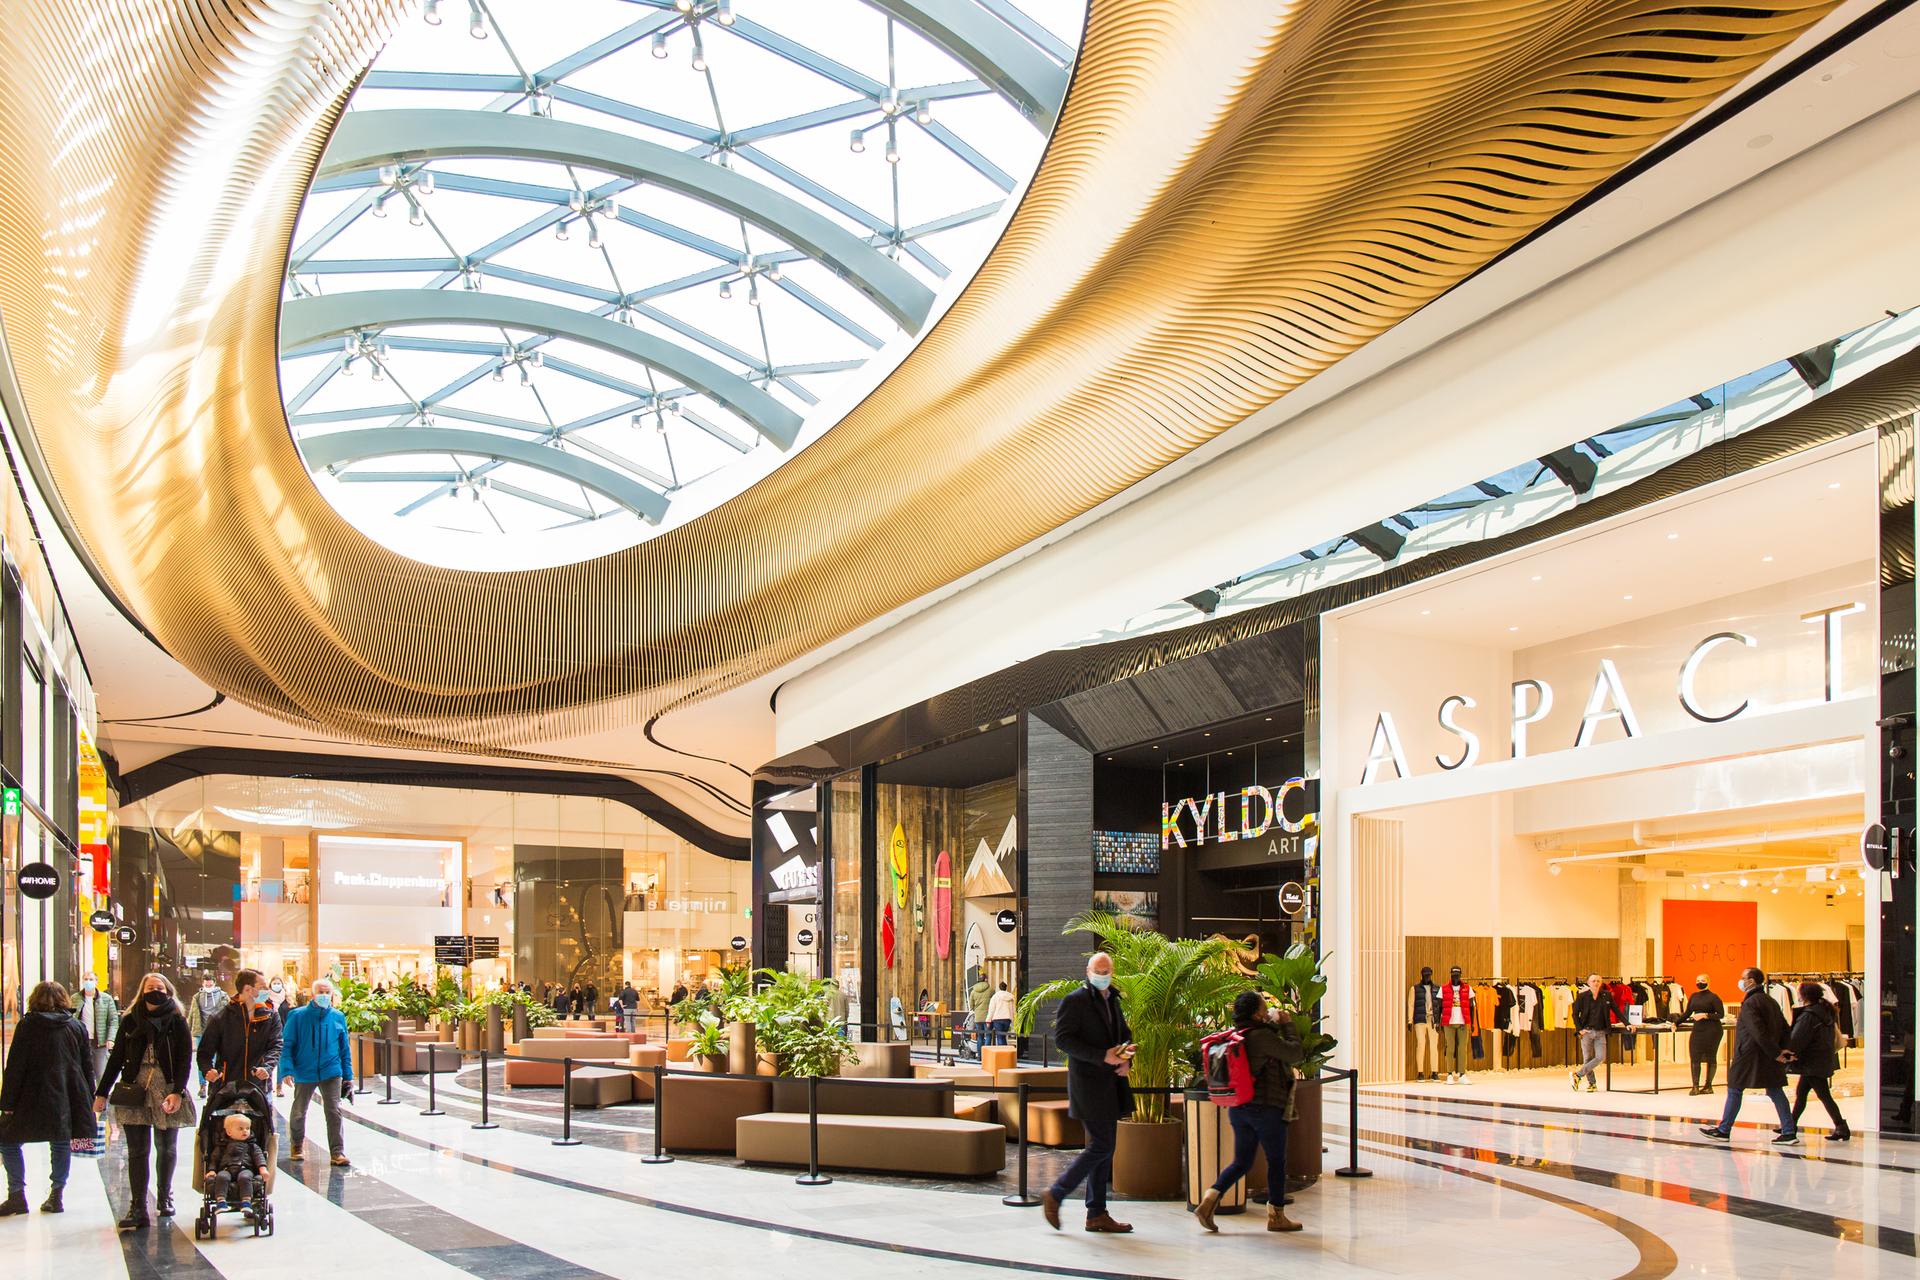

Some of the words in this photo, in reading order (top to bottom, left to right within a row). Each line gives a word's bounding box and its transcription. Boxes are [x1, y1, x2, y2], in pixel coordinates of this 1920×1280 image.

[1360, 602, 1866, 785] ASPACT
[1267, 836, 1300, 856] ART
[1672, 943, 1748, 962] ASPACT
